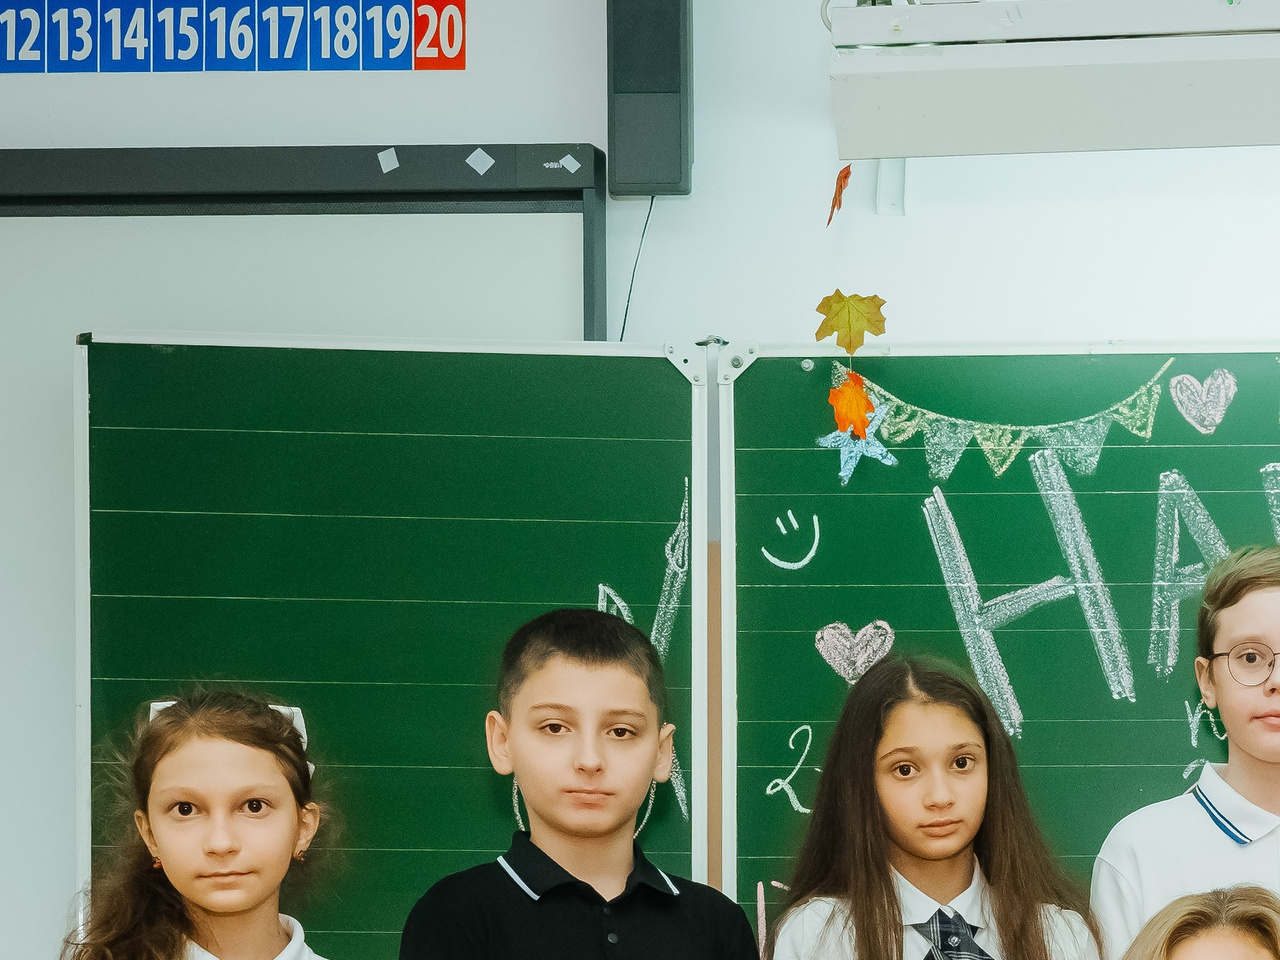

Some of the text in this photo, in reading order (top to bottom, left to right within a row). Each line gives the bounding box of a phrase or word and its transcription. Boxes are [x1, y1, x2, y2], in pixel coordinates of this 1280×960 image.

[0, 5, 465, 60] 12 13 14 15 16 17 18 19 20
